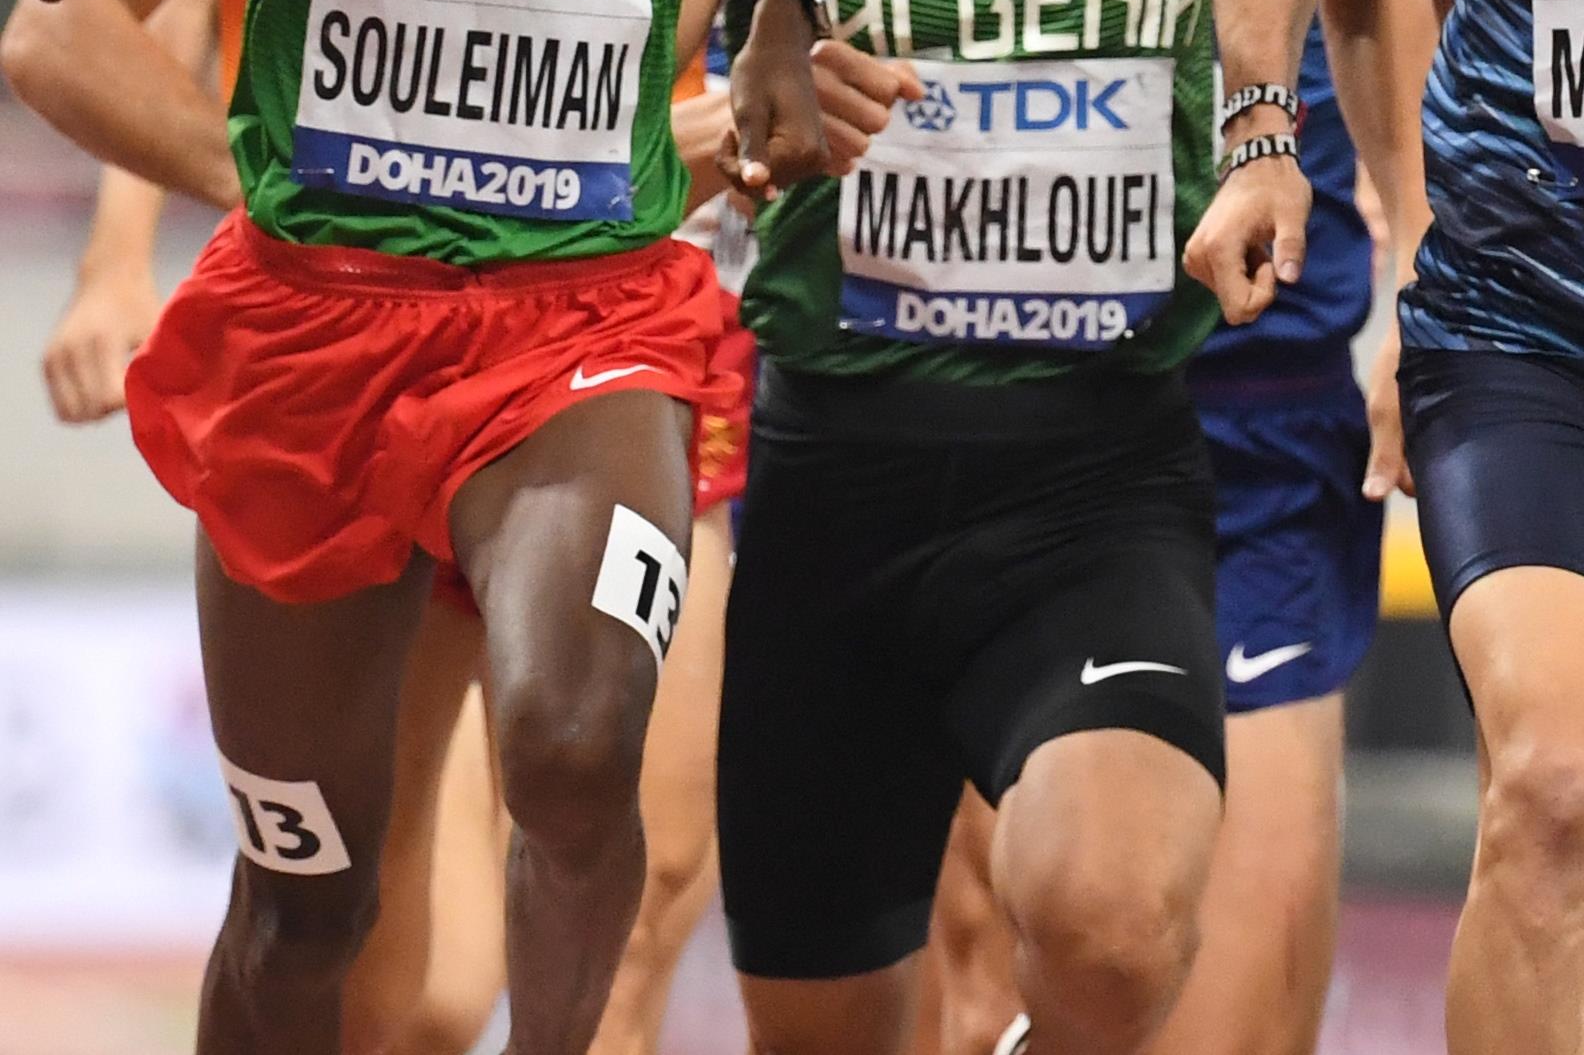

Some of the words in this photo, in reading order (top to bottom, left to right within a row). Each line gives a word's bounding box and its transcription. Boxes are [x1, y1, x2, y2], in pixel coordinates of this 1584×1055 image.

[314, 11, 628, 131] SOULEIMAN
[959, 79, 1130, 132] TDK
[346, 142, 581, 209] DOHA2019
[854, 170, 1159, 264] MAKHLOUFI
[894, 293, 1127, 341] DOHA2019
[633, 550, 683, 654] 13
[228, 784, 321, 860] 13
